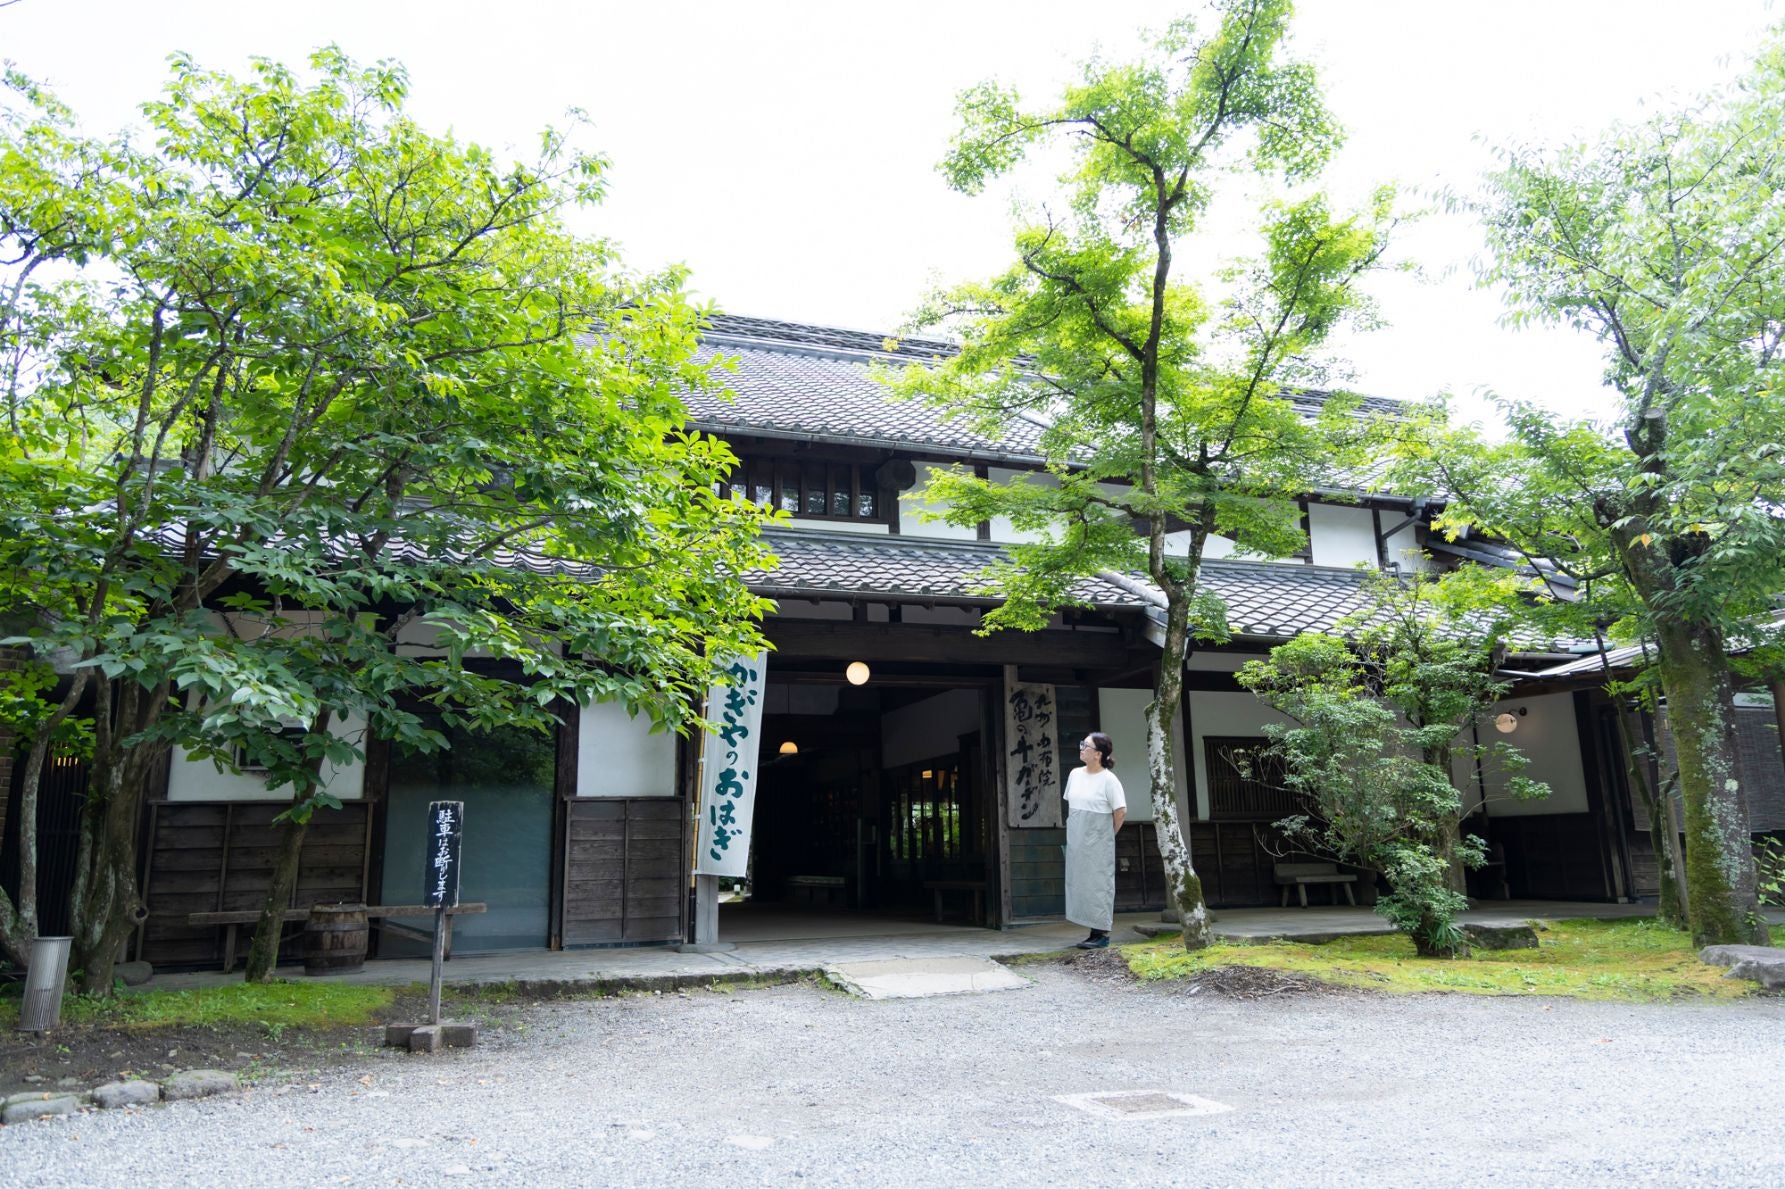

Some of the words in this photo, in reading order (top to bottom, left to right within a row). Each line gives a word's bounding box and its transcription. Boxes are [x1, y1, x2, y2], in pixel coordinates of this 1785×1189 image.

[710, 662, 758, 861] かぎやのおはぎ
[432, 809, 456, 902] 駐車はお断りします
